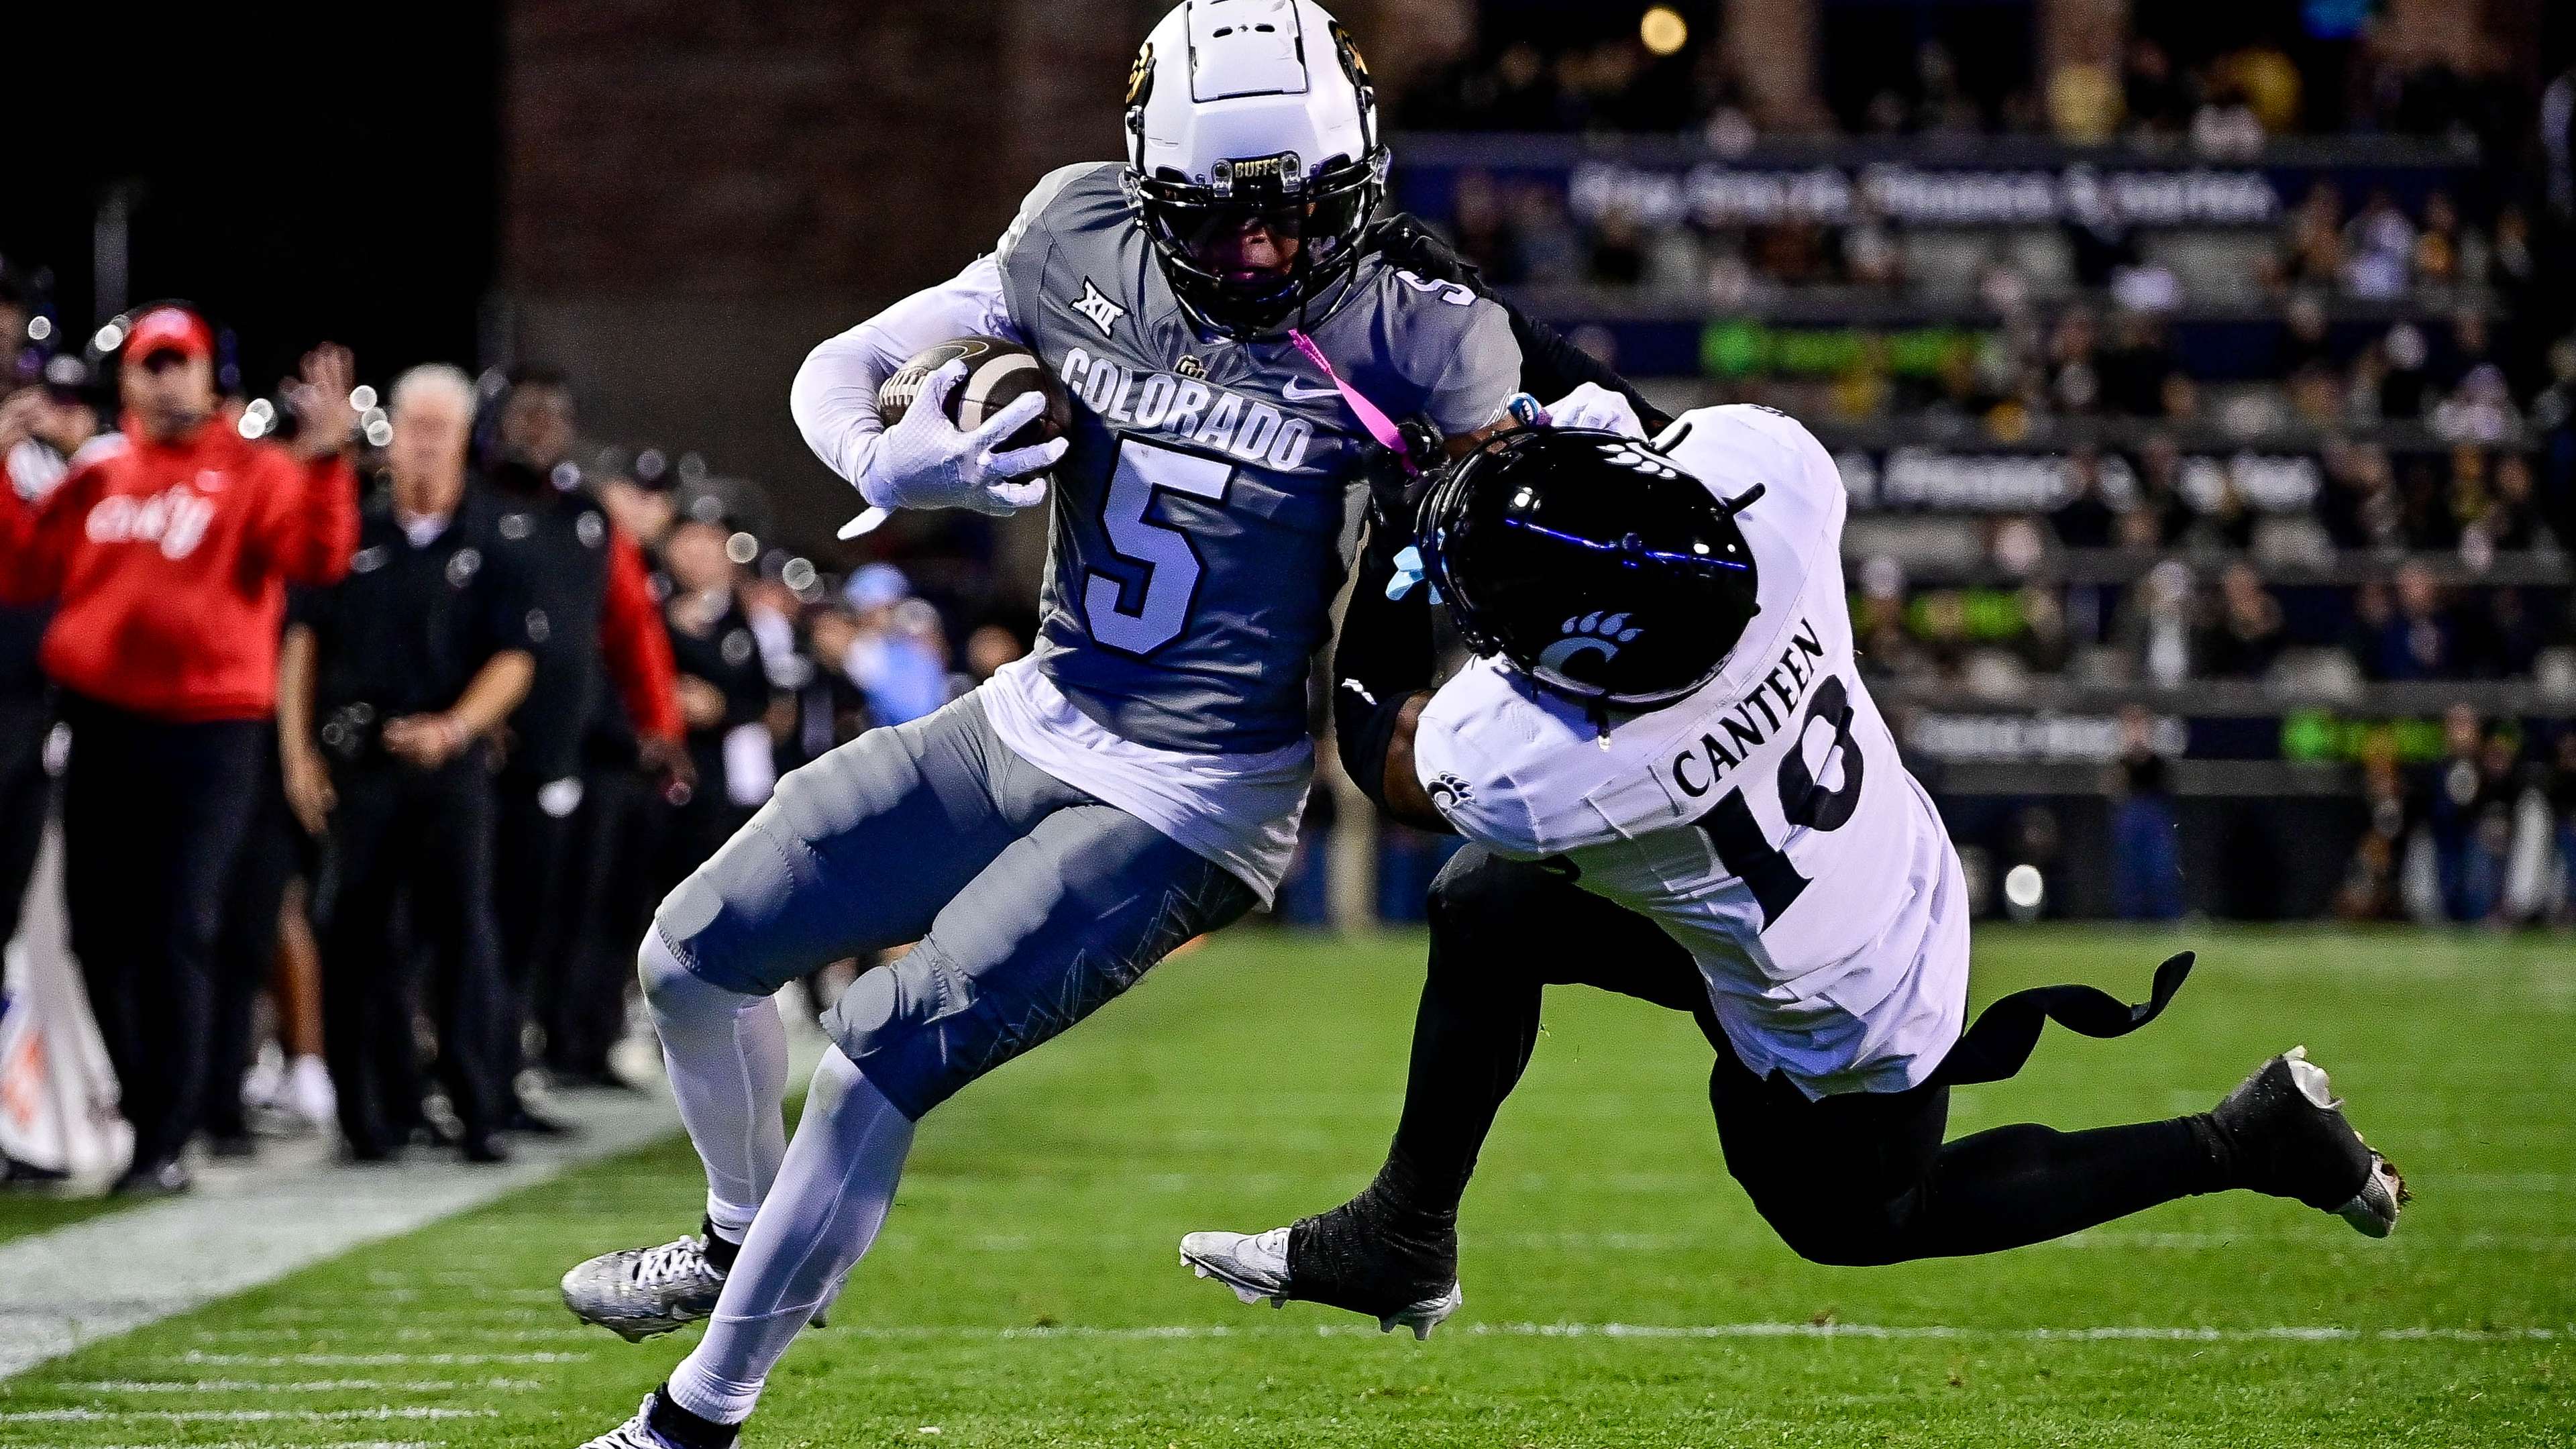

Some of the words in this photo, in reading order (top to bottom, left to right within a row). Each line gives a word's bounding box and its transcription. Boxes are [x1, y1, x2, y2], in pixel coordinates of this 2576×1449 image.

[1235, 158, 1279, 178] BUFFS
[1071, 279, 1125, 337] XII
[1060, 347, 1313, 470] COLORADO
[1082, 435, 1234, 657] 5
[1672, 616, 1825, 798] CANTEEN
